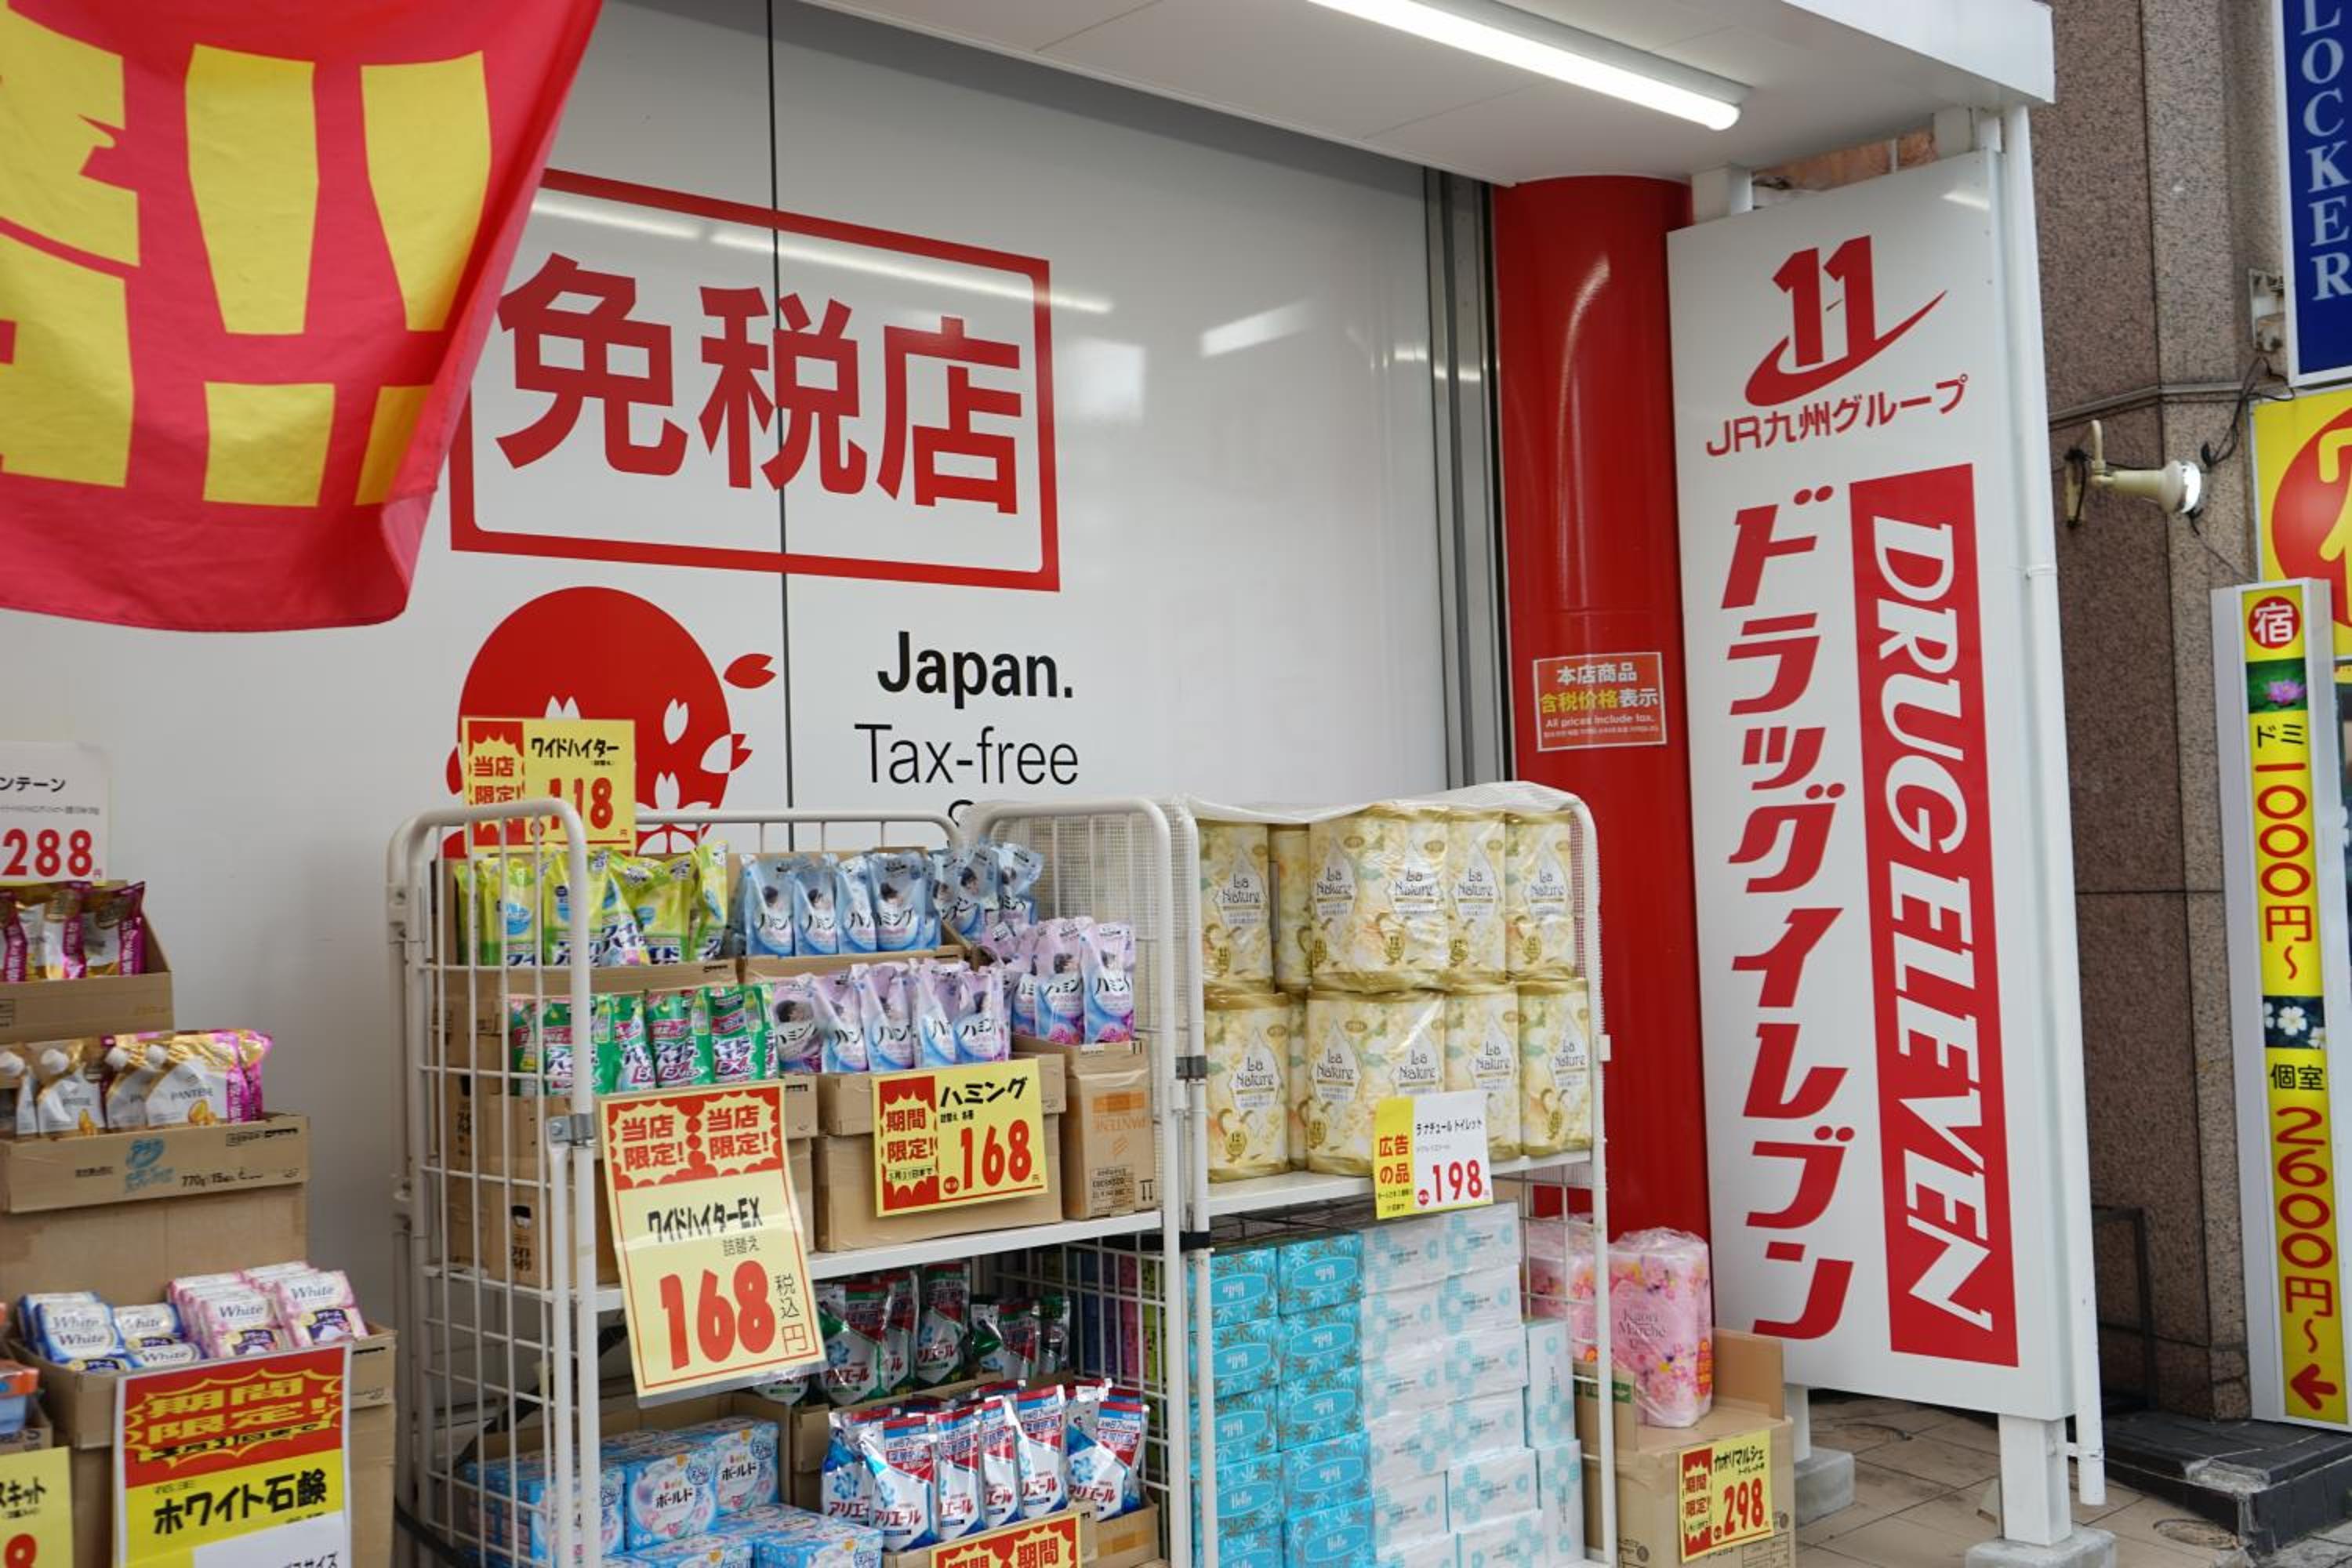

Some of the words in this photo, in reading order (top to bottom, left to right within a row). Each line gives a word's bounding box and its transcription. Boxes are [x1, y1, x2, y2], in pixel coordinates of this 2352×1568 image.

[2299, 0, 2352, 300] LOCKER
[495, 252, 1022, 515] 免税店
[1707, 373, 1969, 458] JR九州グループ
[2254, 601, 2294, 644] 宿
[877, 630, 1074, 710] Japan.
[1556, 662, 1638, 685] 本店商品
[1541, 688, 1659, 713] 含税价格表示
[1594, 713, 1633, 725] include
[531, 737, 619, 759] ワイドハイター
[2257, 724, 2304, 748] ドミ
[474, 755, 514, 778] 当店
[855, 724, 1080, 786] Tax-free
[549, 777, 614, 830] 118
[2, 828, 93, 877] 288
[1721, 485, 1854, 1341] ドラッグイレブン
[940, 1076, 1029, 1108] ハミング
[2270, 1064, 2326, 1091] 個室
[621, 1113, 674, 1144] 当店
[708, 1105, 760, 1134] 当店
[885, 1107, 927, 1134] 期間
[626, 1142, 684, 1171] 限定!
[710, 1131, 769, 1161] 限定!
[887, 1137, 934, 1164] 限定!
[960, 1119, 1033, 1190] 168
[1379, 1134, 1410, 1158] 広告
[1379, 1162, 1410, 1185] の品
[1432, 1159, 1483, 1203] 198
[647, 1196, 763, 1243] ワイドハイターEX
[723, 1236, 760, 1257] 詰替え
[219, 1303, 264, 1319] White
[775, 1273, 800, 1319] 税込
[659, 1260, 775, 1371] 168
[59, 1333, 106, 1346] White
[782, 1323, 808, 1356] 円
[148, 1377, 304, 1418] 期間
[148, 1396, 327, 1445] 限定!
[153, 1468, 327, 1534] ホワイト石鹸
[1723, 1477, 1764, 1537] 298
